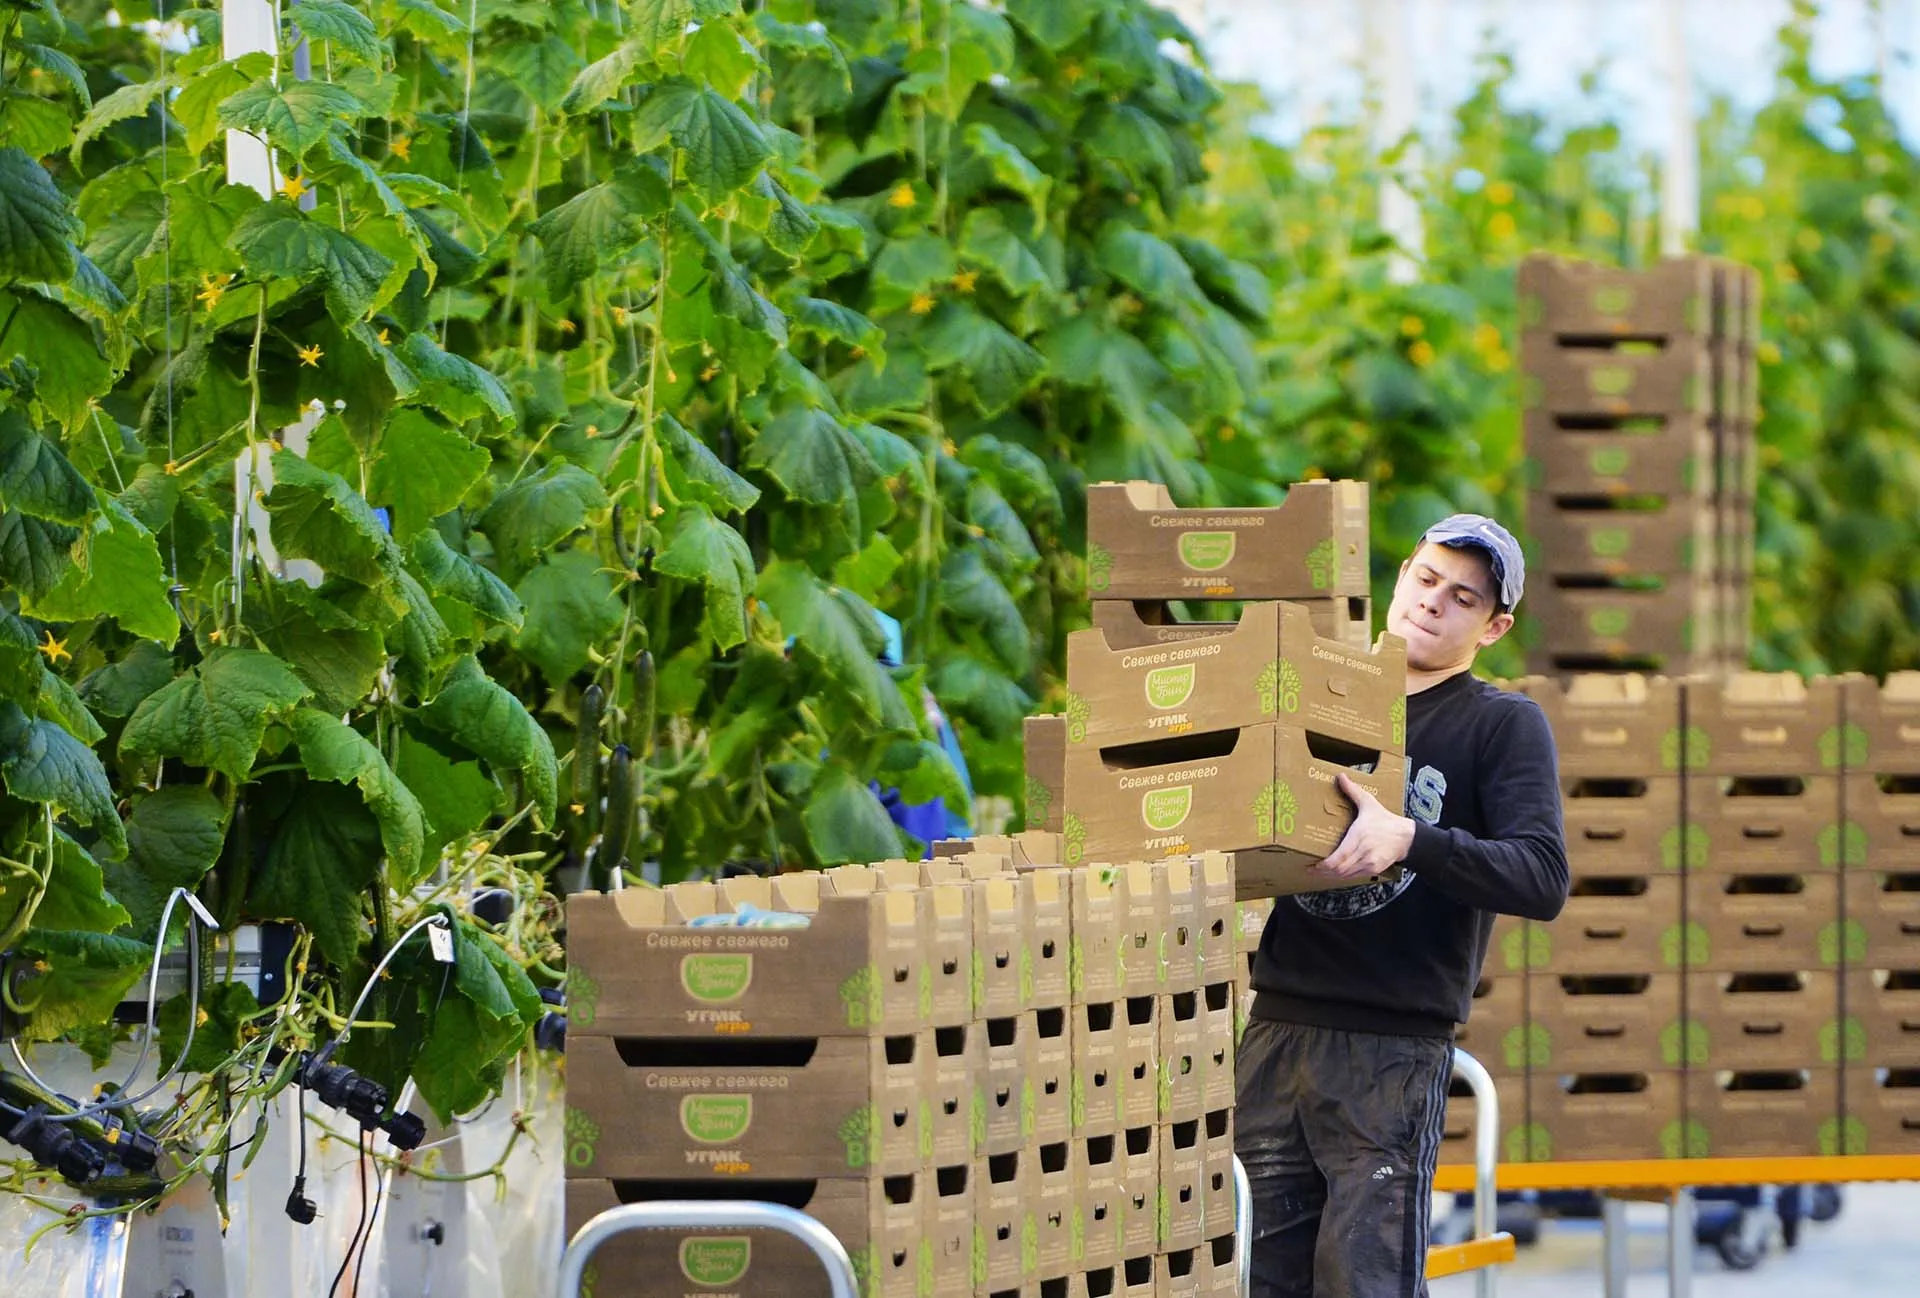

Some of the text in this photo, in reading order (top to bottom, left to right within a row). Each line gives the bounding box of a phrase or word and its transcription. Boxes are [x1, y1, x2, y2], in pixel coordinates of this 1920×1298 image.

[1151, 515, 1203, 527] Свежее
[1182, 576, 1229, 587] УГМК
[1122, 644, 1220, 668] Свежее свежего
[1312, 645, 1382, 676] Свежее свежего
[1148, 712, 1189, 728] УГМК
[1168, 722, 1193, 734] агро
[1119, 766, 1218, 790] Свежее свежего
[1144, 834, 1185, 850] УГМК
[1164, 844, 1190, 856] агро
[646, 932, 789, 948] Свежее свежего
[686, 1010, 743, 1022] УГМК
[646, 1073, 788, 1088] Свежее свежего
[685, 1150, 743, 1163] УГМК
